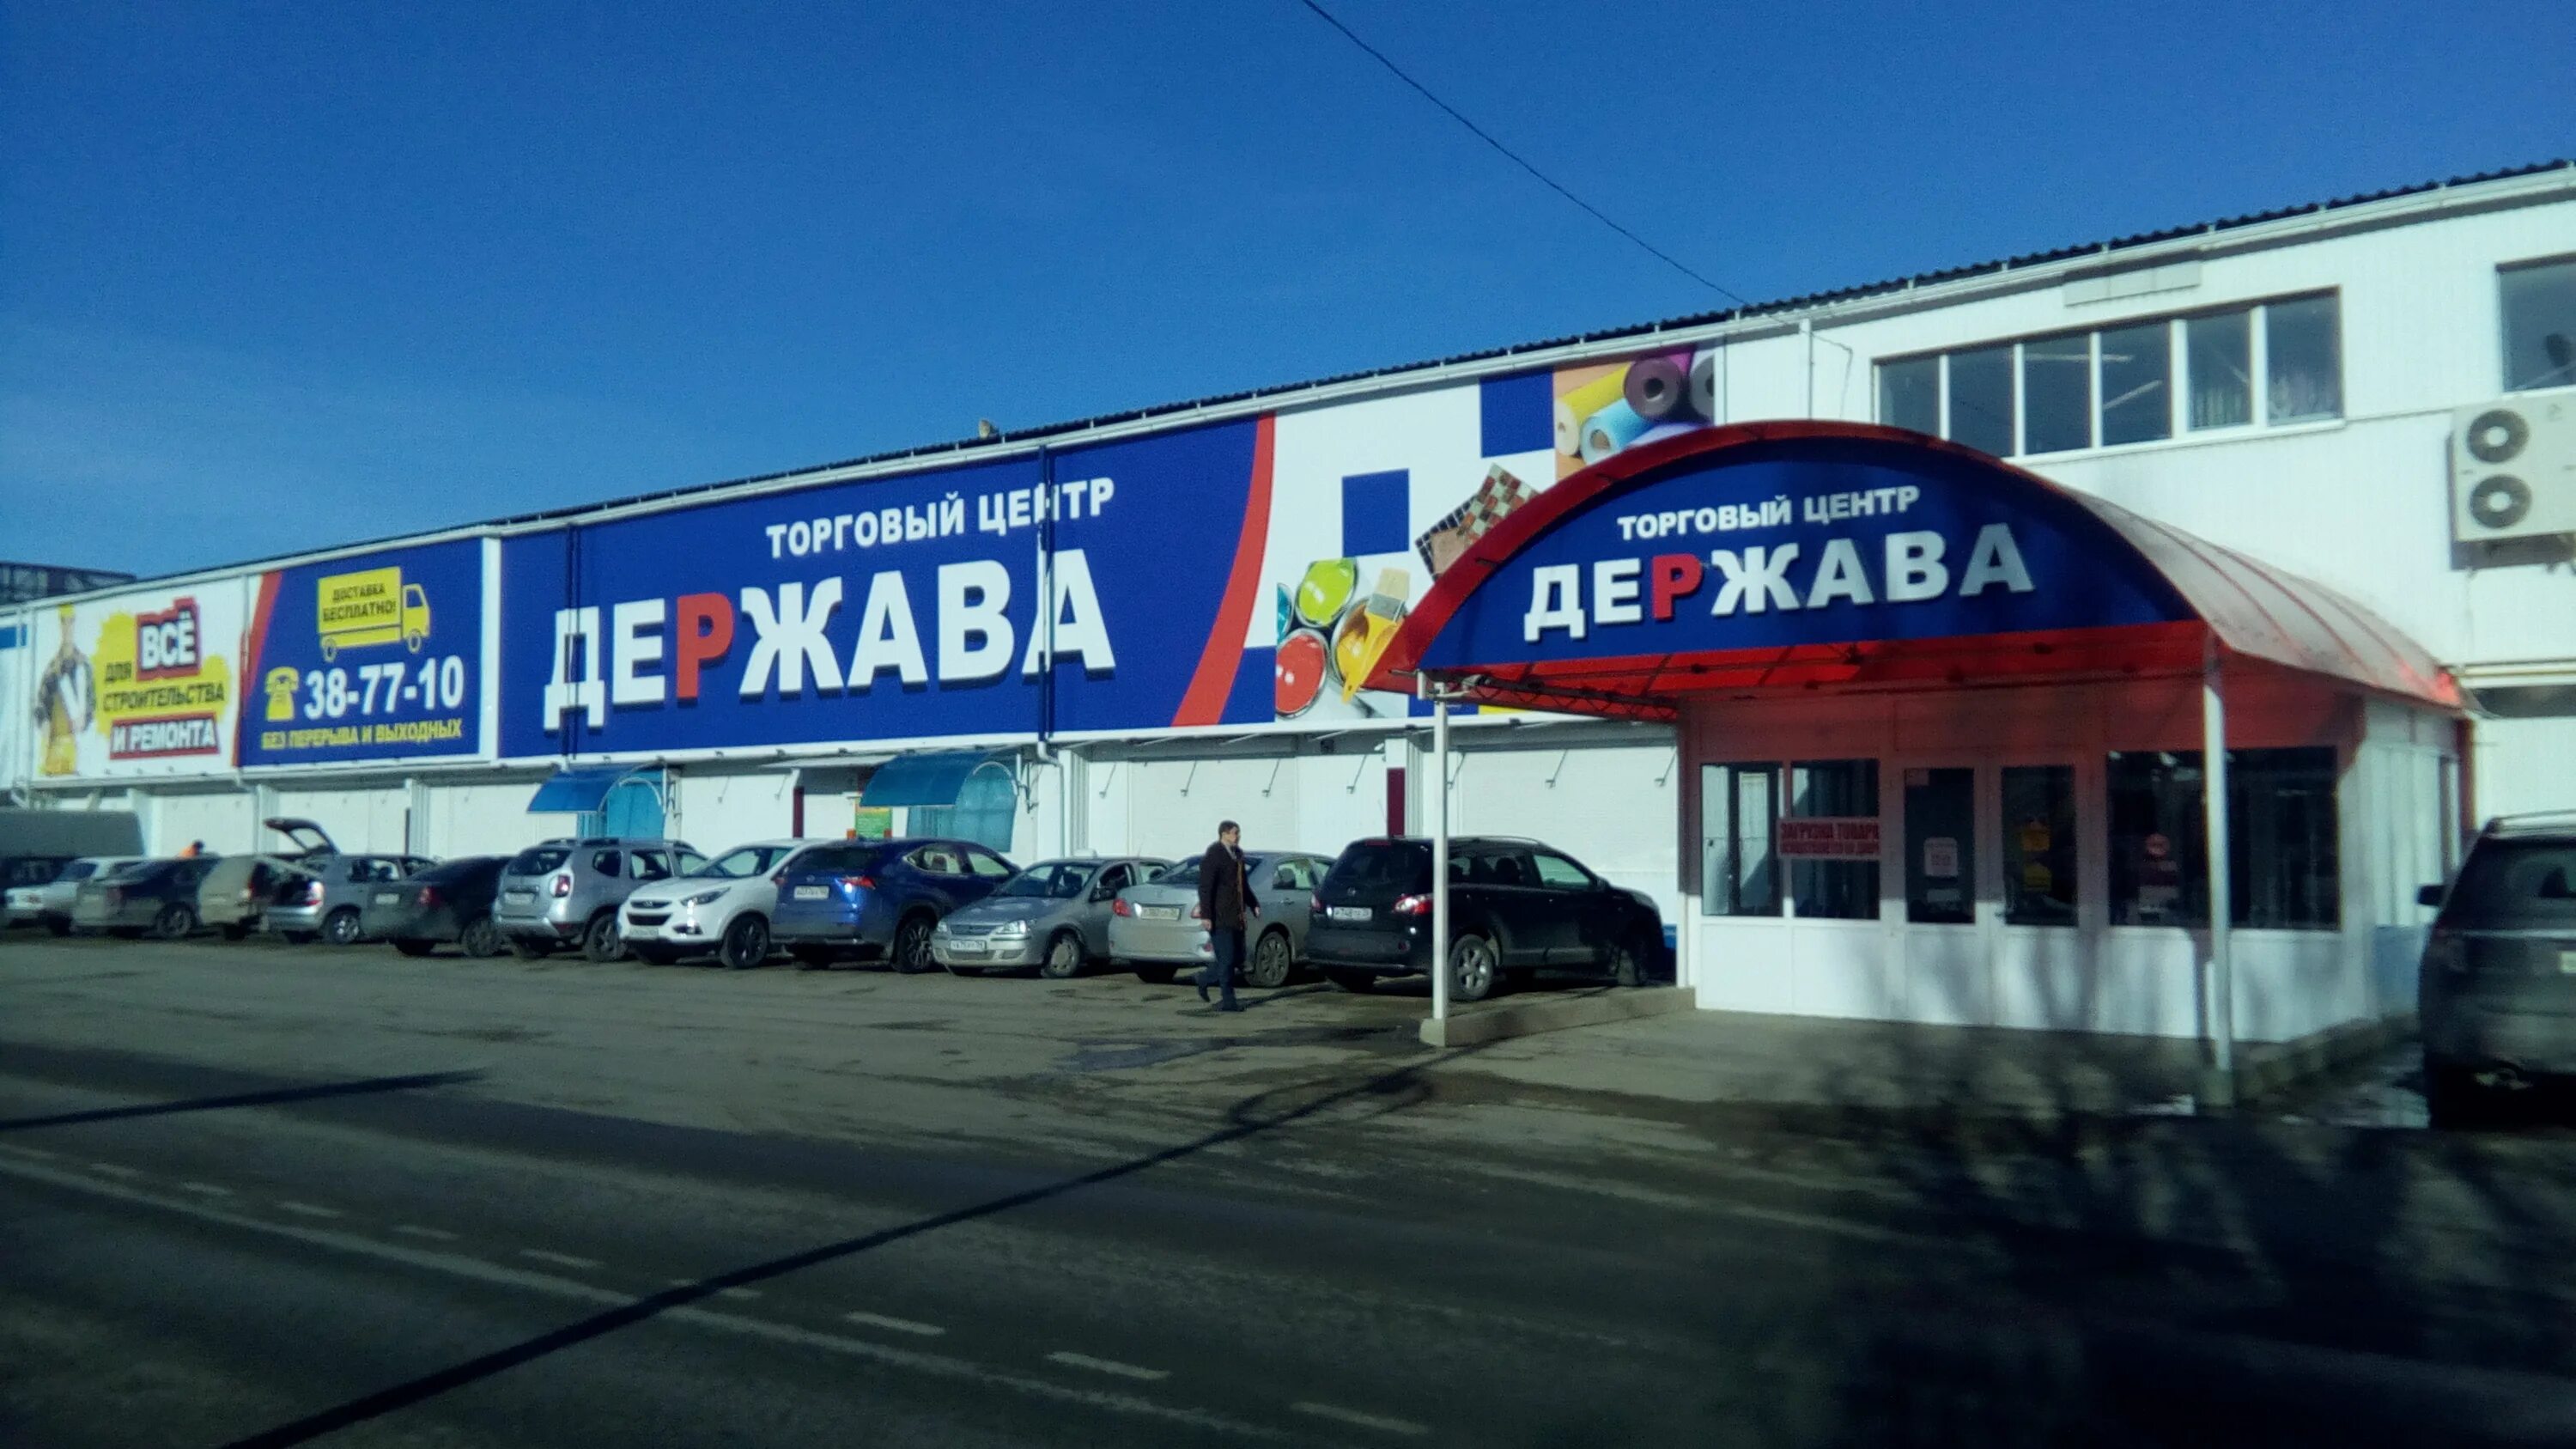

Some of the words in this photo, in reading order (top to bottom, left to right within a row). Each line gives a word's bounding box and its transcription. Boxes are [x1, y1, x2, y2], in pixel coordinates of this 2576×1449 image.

[766, 492, 964, 557] ТОРГОВЫЙ
[978, 478, 1115, 537] ЦЕНТР
[1618, 495, 1792, 541] ТОРГОВЫЙ
[1803, 485, 1921, 527] ЦЕНТР
[332, 583, 386, 601] ДОСТАВКА
[1523, 522, 2035, 642] ДЕРЖАВА
[323, 600, 397, 622] БЕСПЛАТНО!
[141, 610, 196, 670] ВСЁ
[543, 548, 1116, 732] ДЕРЖАВА
[104, 661, 132, 684] ДЛЯ
[304, 654, 465, 720] 38-77-10
[102, 682, 225, 712] СТРОИТЕЛЬСТВА
[112, 726, 128, 753] И
[131, 718, 216, 752] РЕМОНТА
[376, 718, 462, 743] ВЫХОДНЫХ
